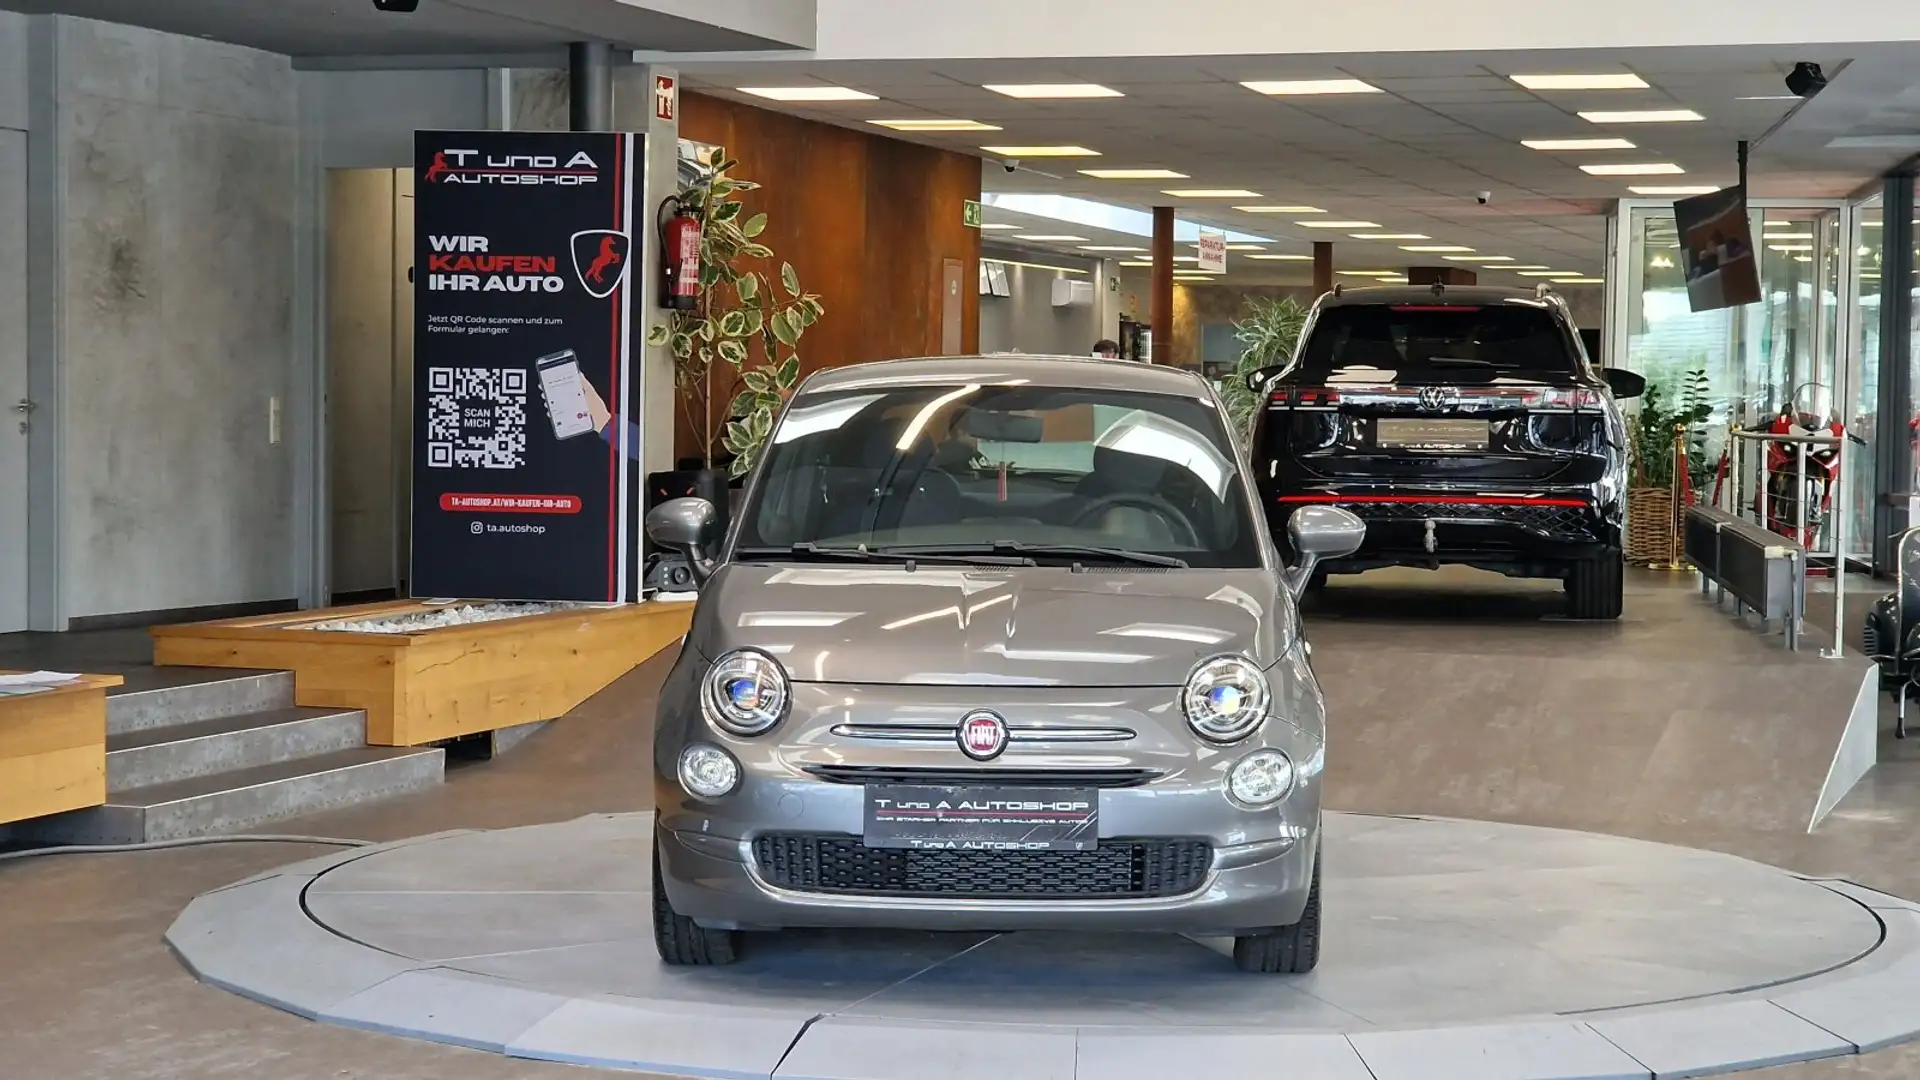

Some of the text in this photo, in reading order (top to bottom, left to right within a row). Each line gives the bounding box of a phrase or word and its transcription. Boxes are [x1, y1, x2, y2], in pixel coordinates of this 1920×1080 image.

[444, 149, 479, 167] T
[564, 151, 599, 169] A
[444, 173, 598, 186] AUTOSHOP
[429, 235, 489, 252] WIR
[429, 255, 556, 273] KAUFEN
[429, 274, 564, 293] IHR AUTO
[428, 314, 563, 325] Jetzt QR Code scannen und zum
[428, 325, 466, 333] Formular
[464, 408, 491, 418] SCAN
[464, 419, 491, 428] MICH
[486, 523, 546, 535] ta.autoshop
[970, 725, 997, 746] FIAT
[875, 799, 891, 808] T
[936, 800, 951, 810] A
[958, 801, 1089, 811] AUTOSHOP
[910, 840, 923, 848] T
[945, 841, 957, 849] A
[962, 841, 1050, 850] AUTOSHOP
